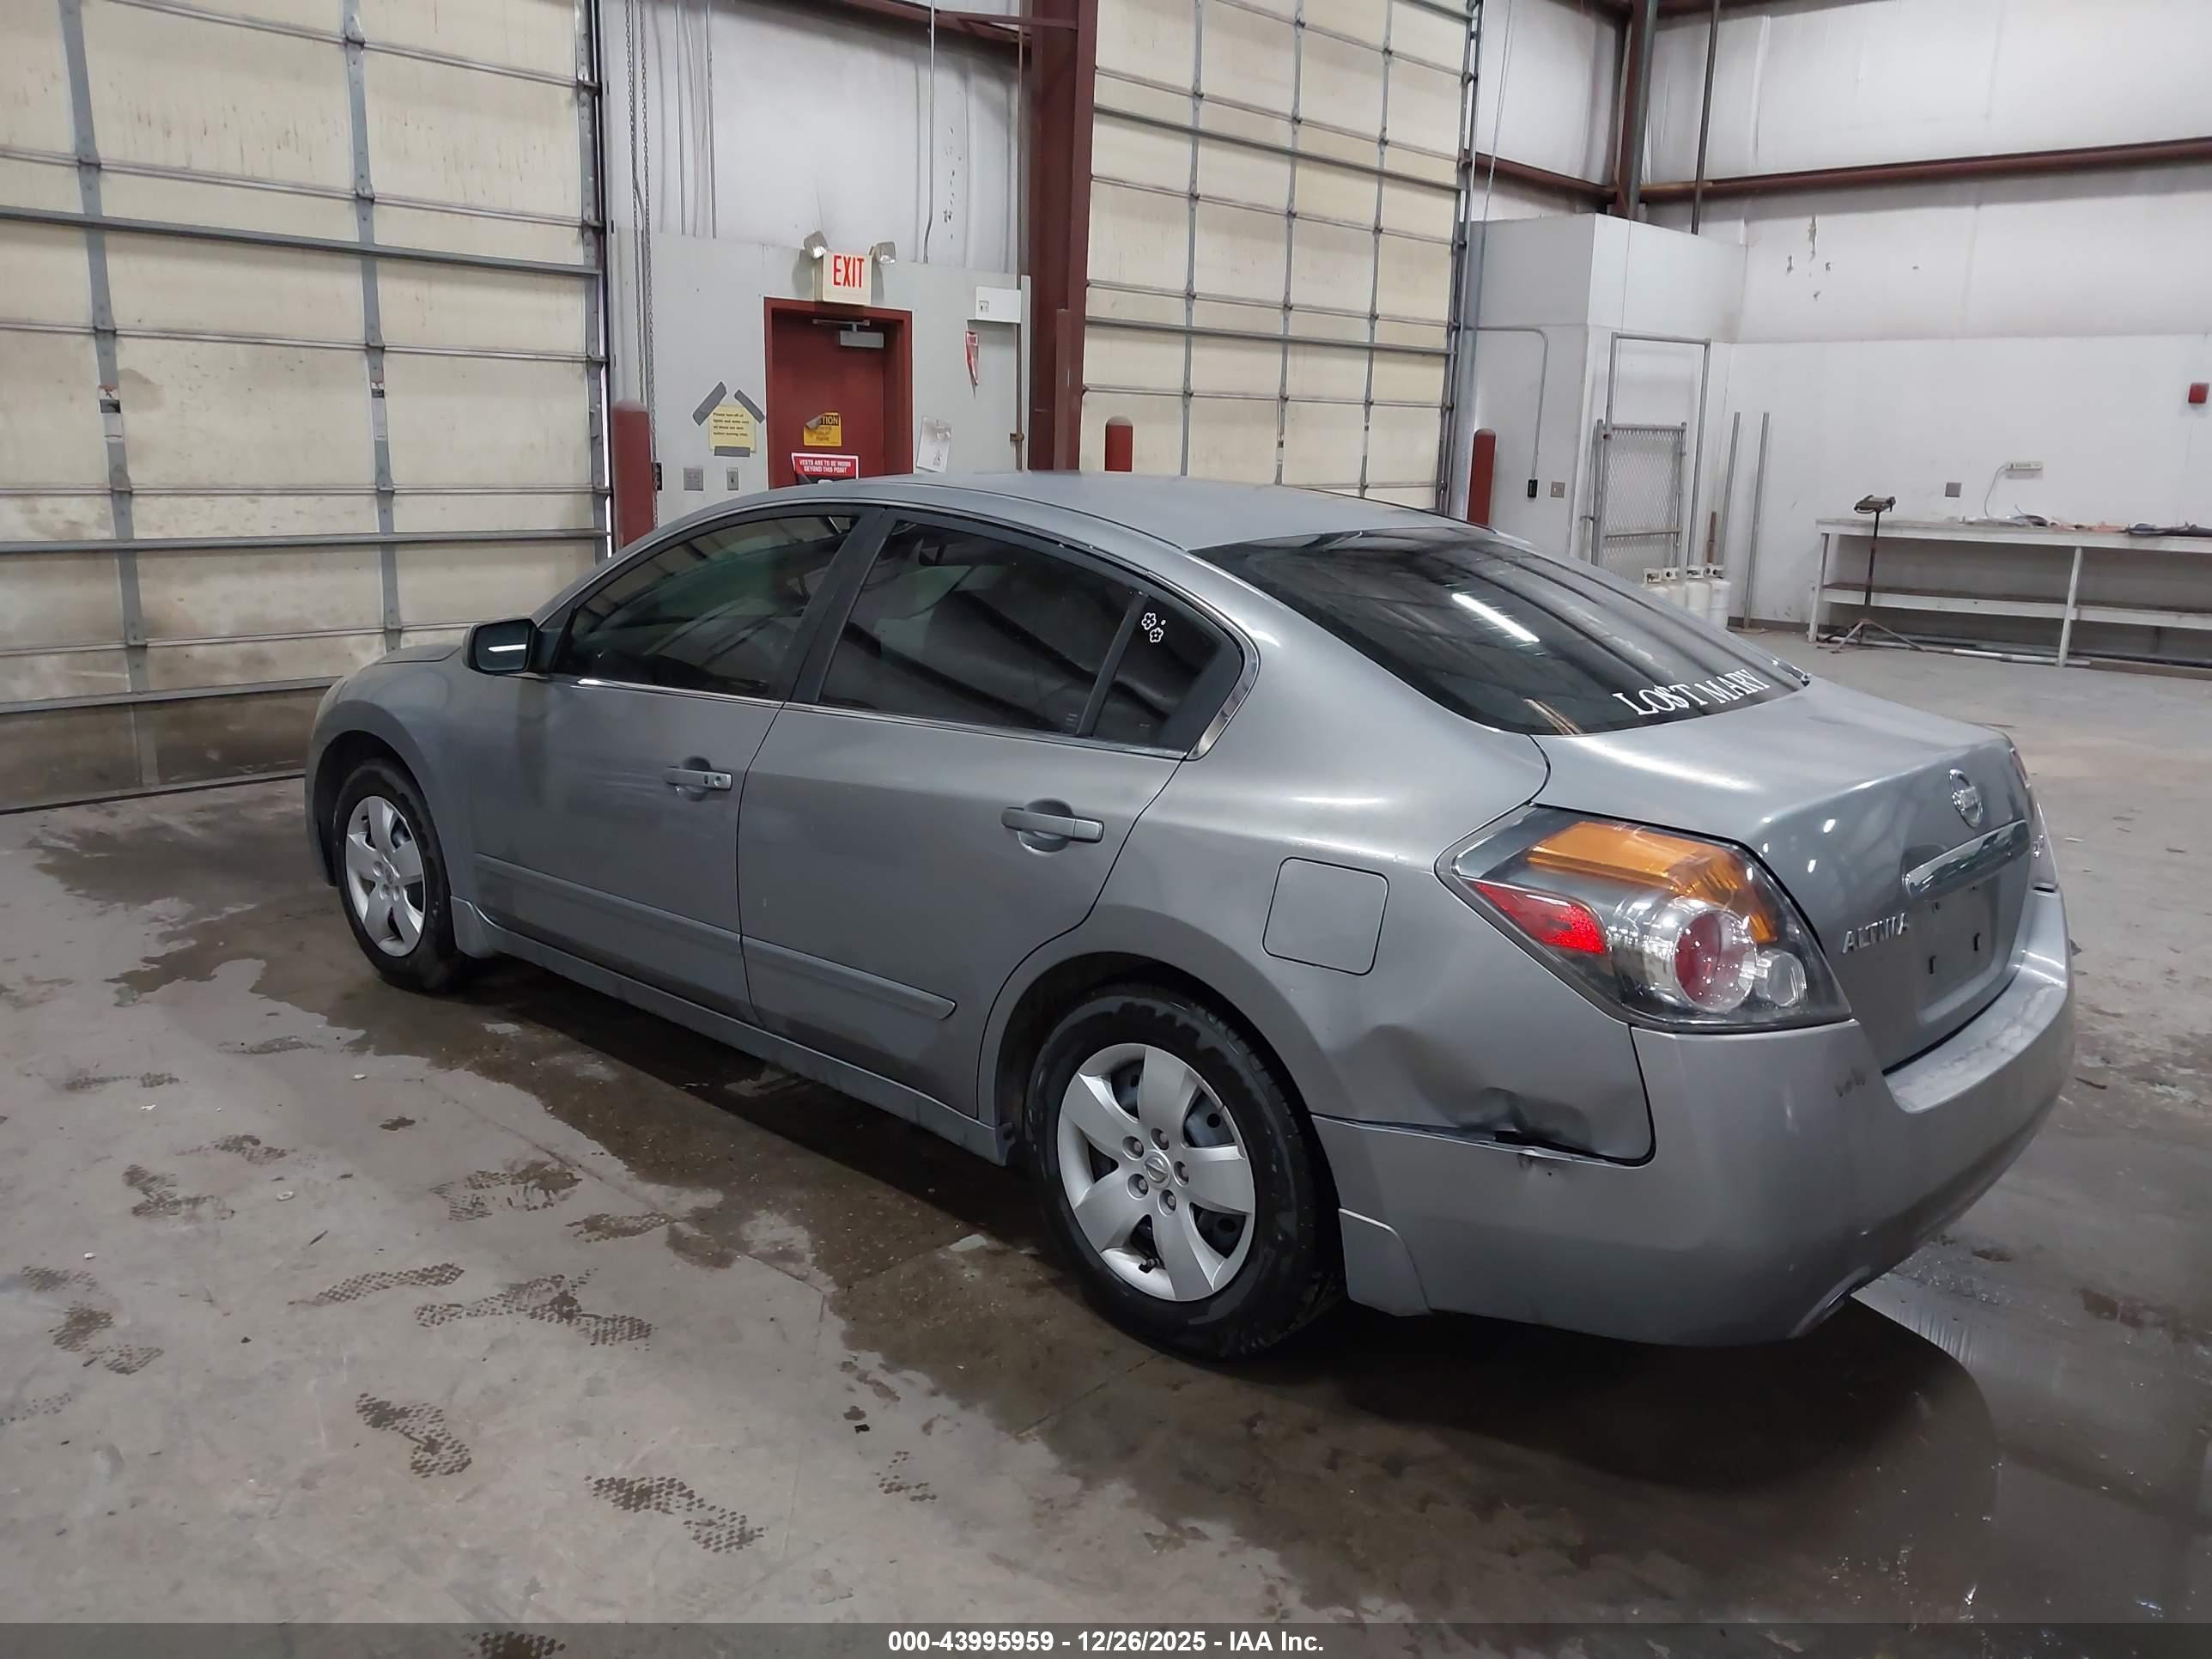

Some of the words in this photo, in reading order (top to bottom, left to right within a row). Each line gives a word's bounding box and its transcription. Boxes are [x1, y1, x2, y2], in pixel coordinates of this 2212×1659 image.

[833, 255, 865, 289] EXIT
[1694, 669, 1771, 704] MARY
[1842, 913, 1909, 954] ALTIMA
